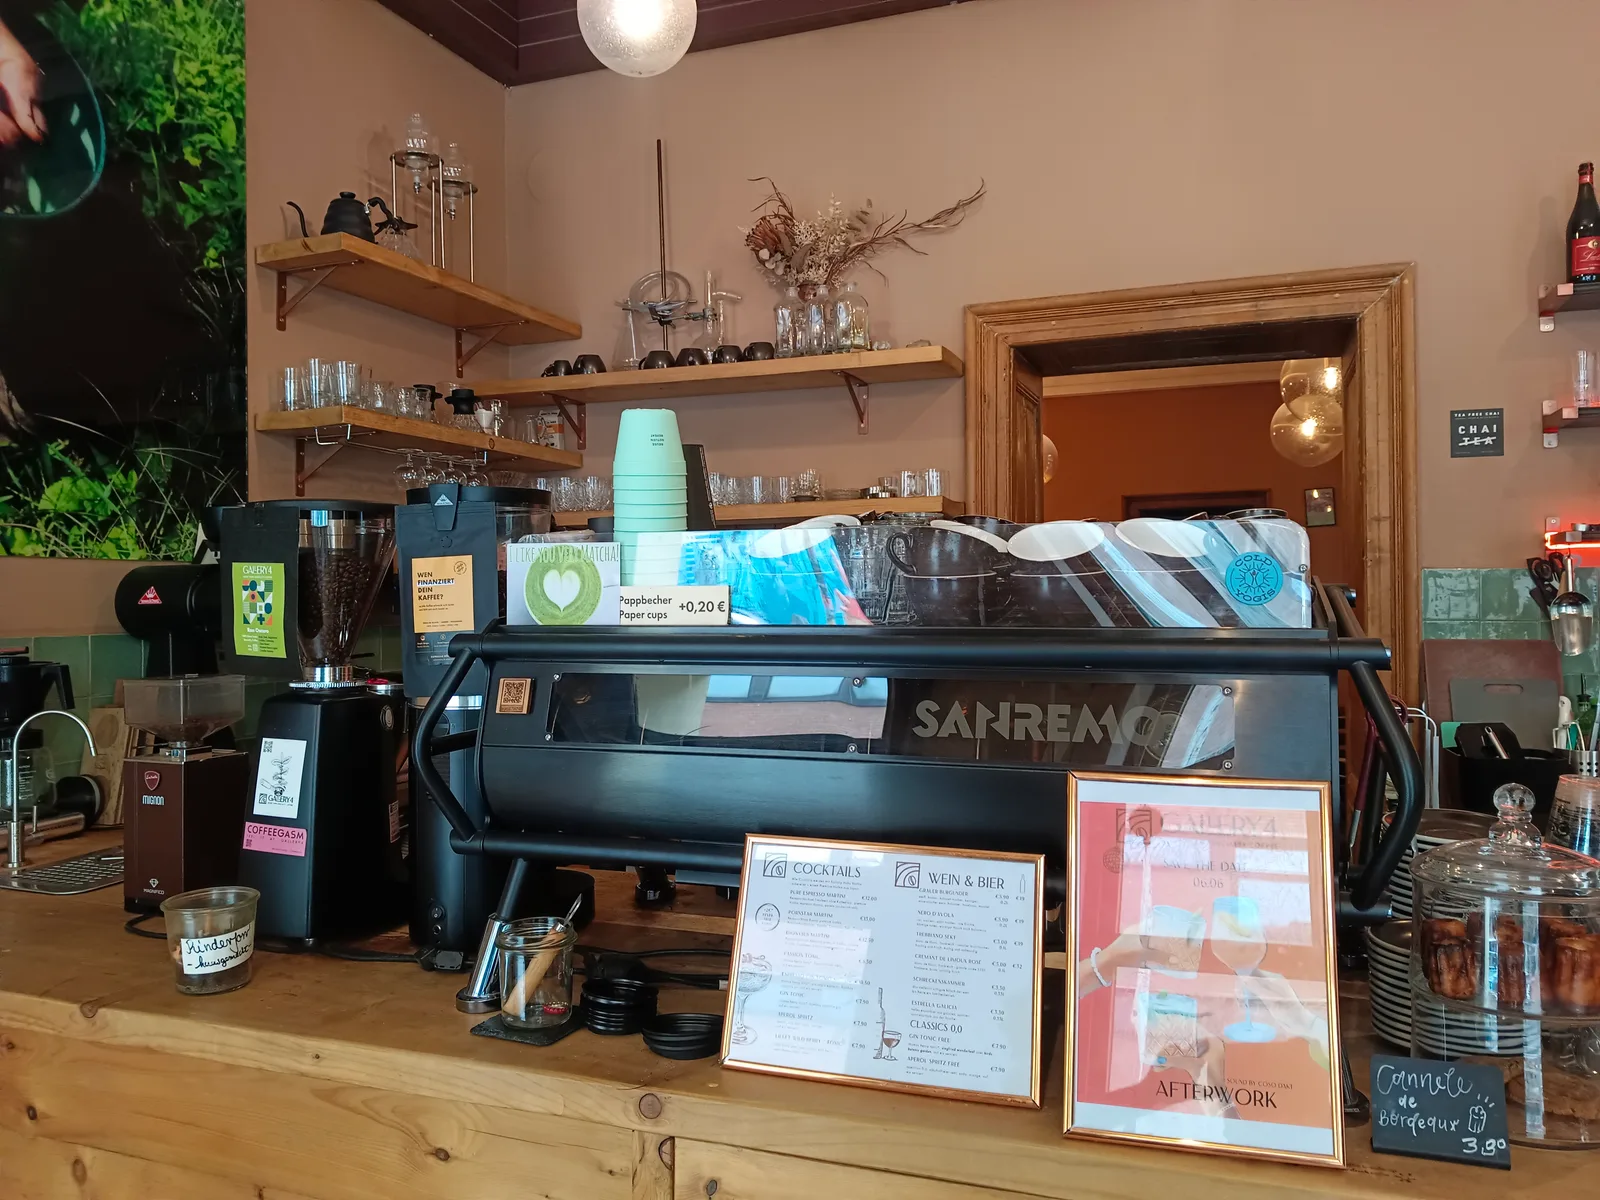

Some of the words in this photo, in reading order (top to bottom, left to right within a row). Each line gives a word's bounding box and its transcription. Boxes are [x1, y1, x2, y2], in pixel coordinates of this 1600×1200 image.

[1458, 424, 1497, 434] CHAI
[1461, 436, 1494, 446] TEA
[515, 546, 535, 563] LIKE
[539, 545, 556, 563] YOU
[581, 543, 619, 563] MATCHA!
[1235, 554, 1273, 567] COLD
[417, 577, 455, 586] FINANZIERT
[620, 595, 673, 610] Pappbecher
[1235, 588, 1276, 602] YOGIS
[678, 600, 714, 614] +0,20
[717, 601, 726, 613] €
[620, 610, 645, 624] Paper
[646, 612, 668, 625] cups
[911, 699, 1161, 746] SANREMO
[247, 824, 304, 840] COFFEEGASM
[793, 862, 862, 878] COCKTAILS
[928, 872, 961, 886] WEIN
[964, 875, 974, 887] &
[977, 876, 1005, 889] BIER
[1192, 876, 1224, 889] 06.06
[910, 1019, 949, 1032] CLASSICS
[950, 1024, 963, 1034] 0,0
[919, 1034, 937, 1042] TONIC
[1155, 1080, 1278, 1109] AFTERWORK
[1398, 1094, 1418, 1109] de
[1378, 1109, 1460, 1137] Bordeaux
